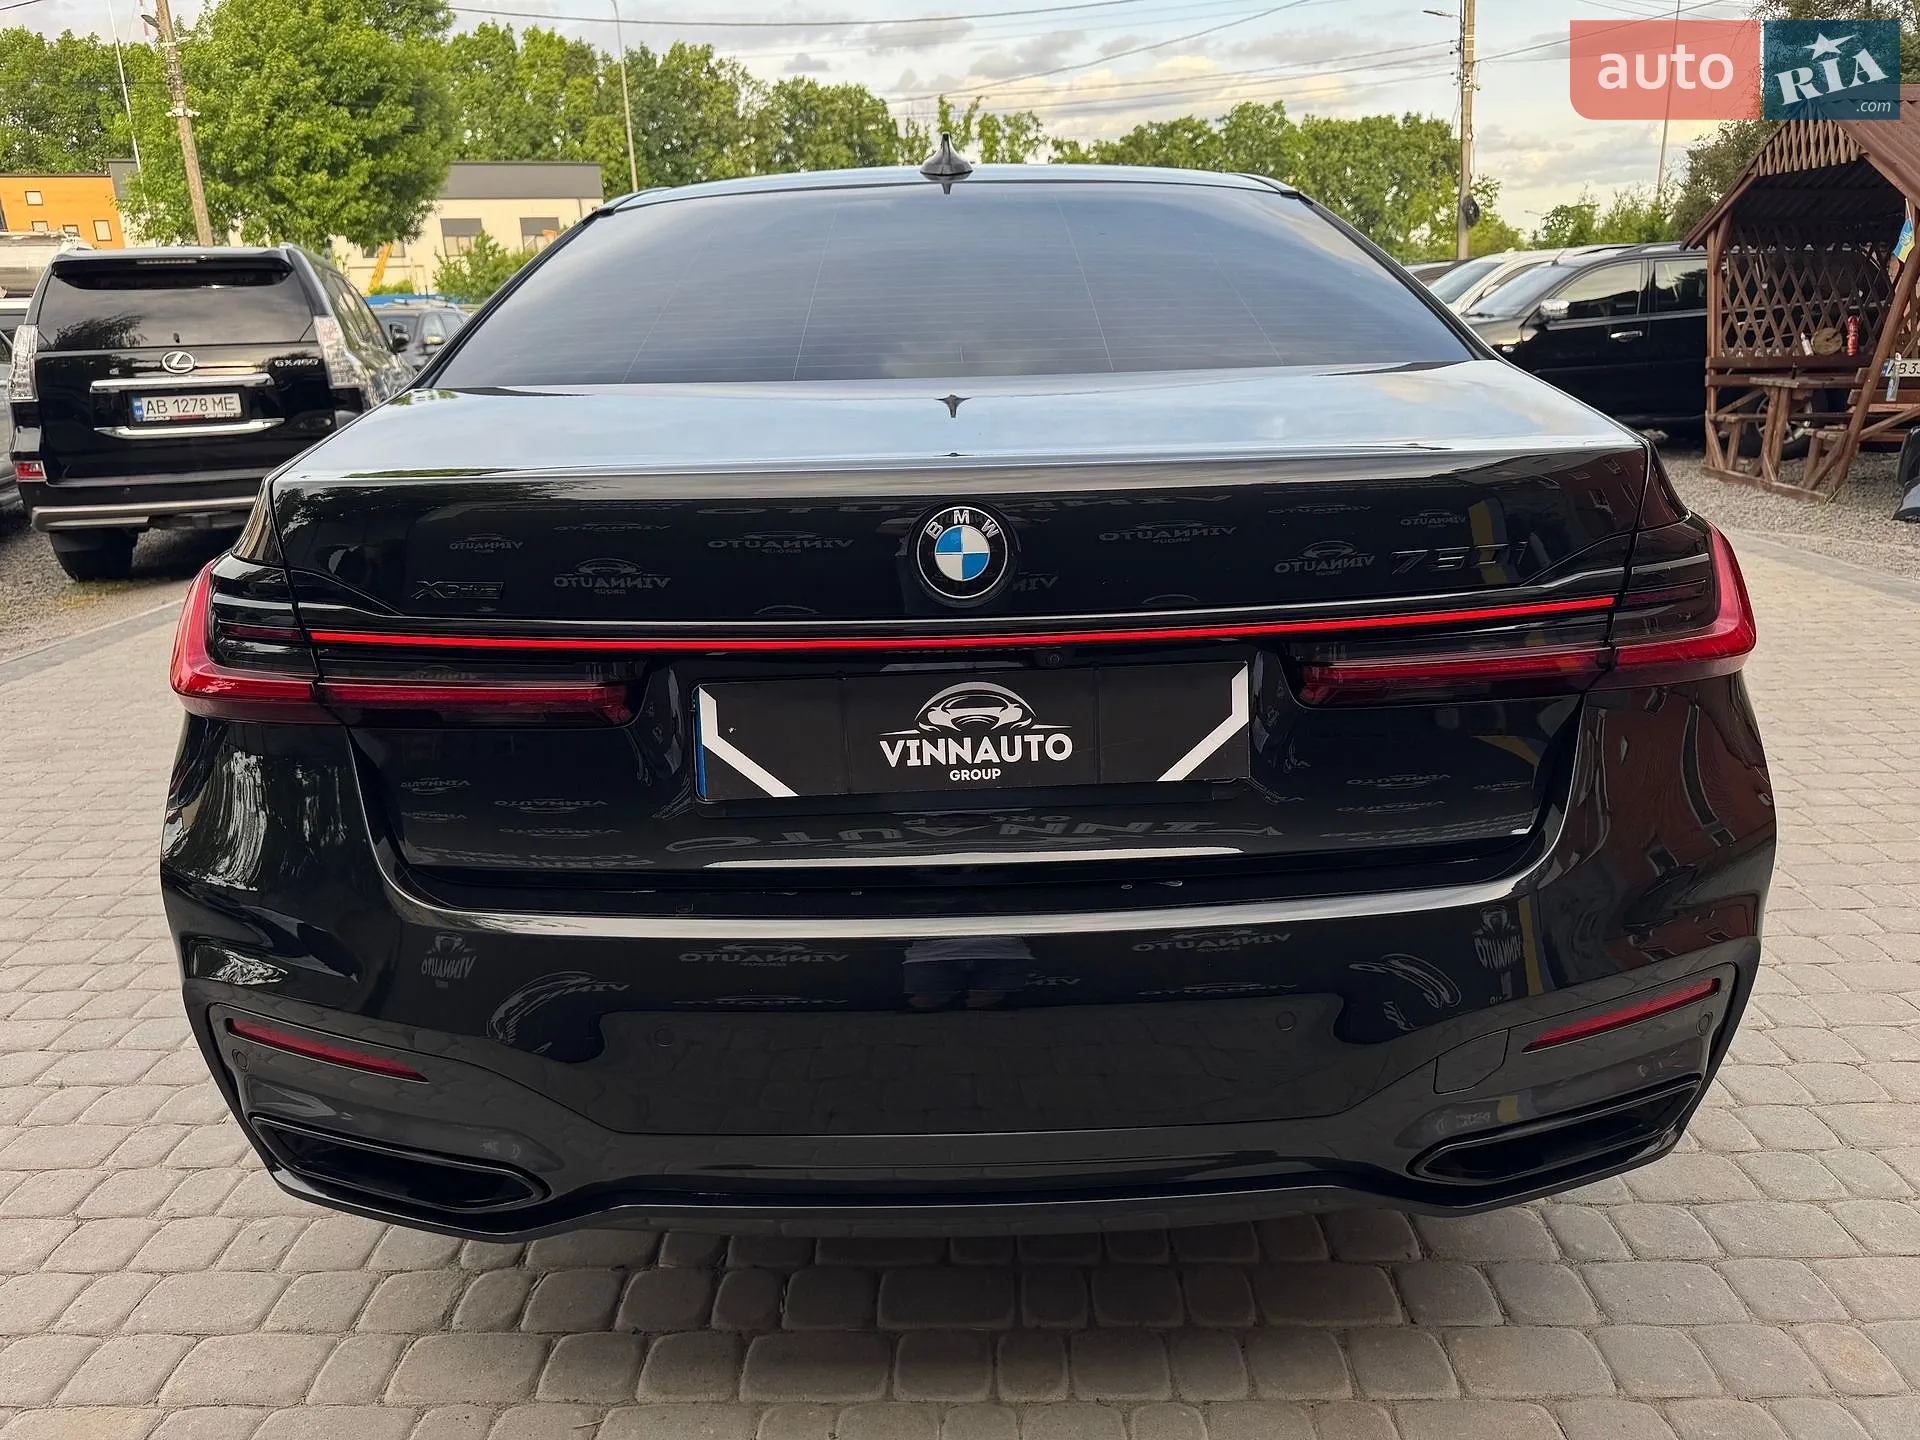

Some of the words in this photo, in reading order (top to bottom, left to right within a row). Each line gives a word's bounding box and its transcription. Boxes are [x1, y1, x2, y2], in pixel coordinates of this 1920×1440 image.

[146, 399, 168, 415] AB
[173, 397, 208, 413] 1278
[211, 396, 236, 412] ME
[925, 509, 1000, 541] BMW
[879, 733, 1073, 768] VINNAUTO
[949, 768, 1002, 781] GROUP
